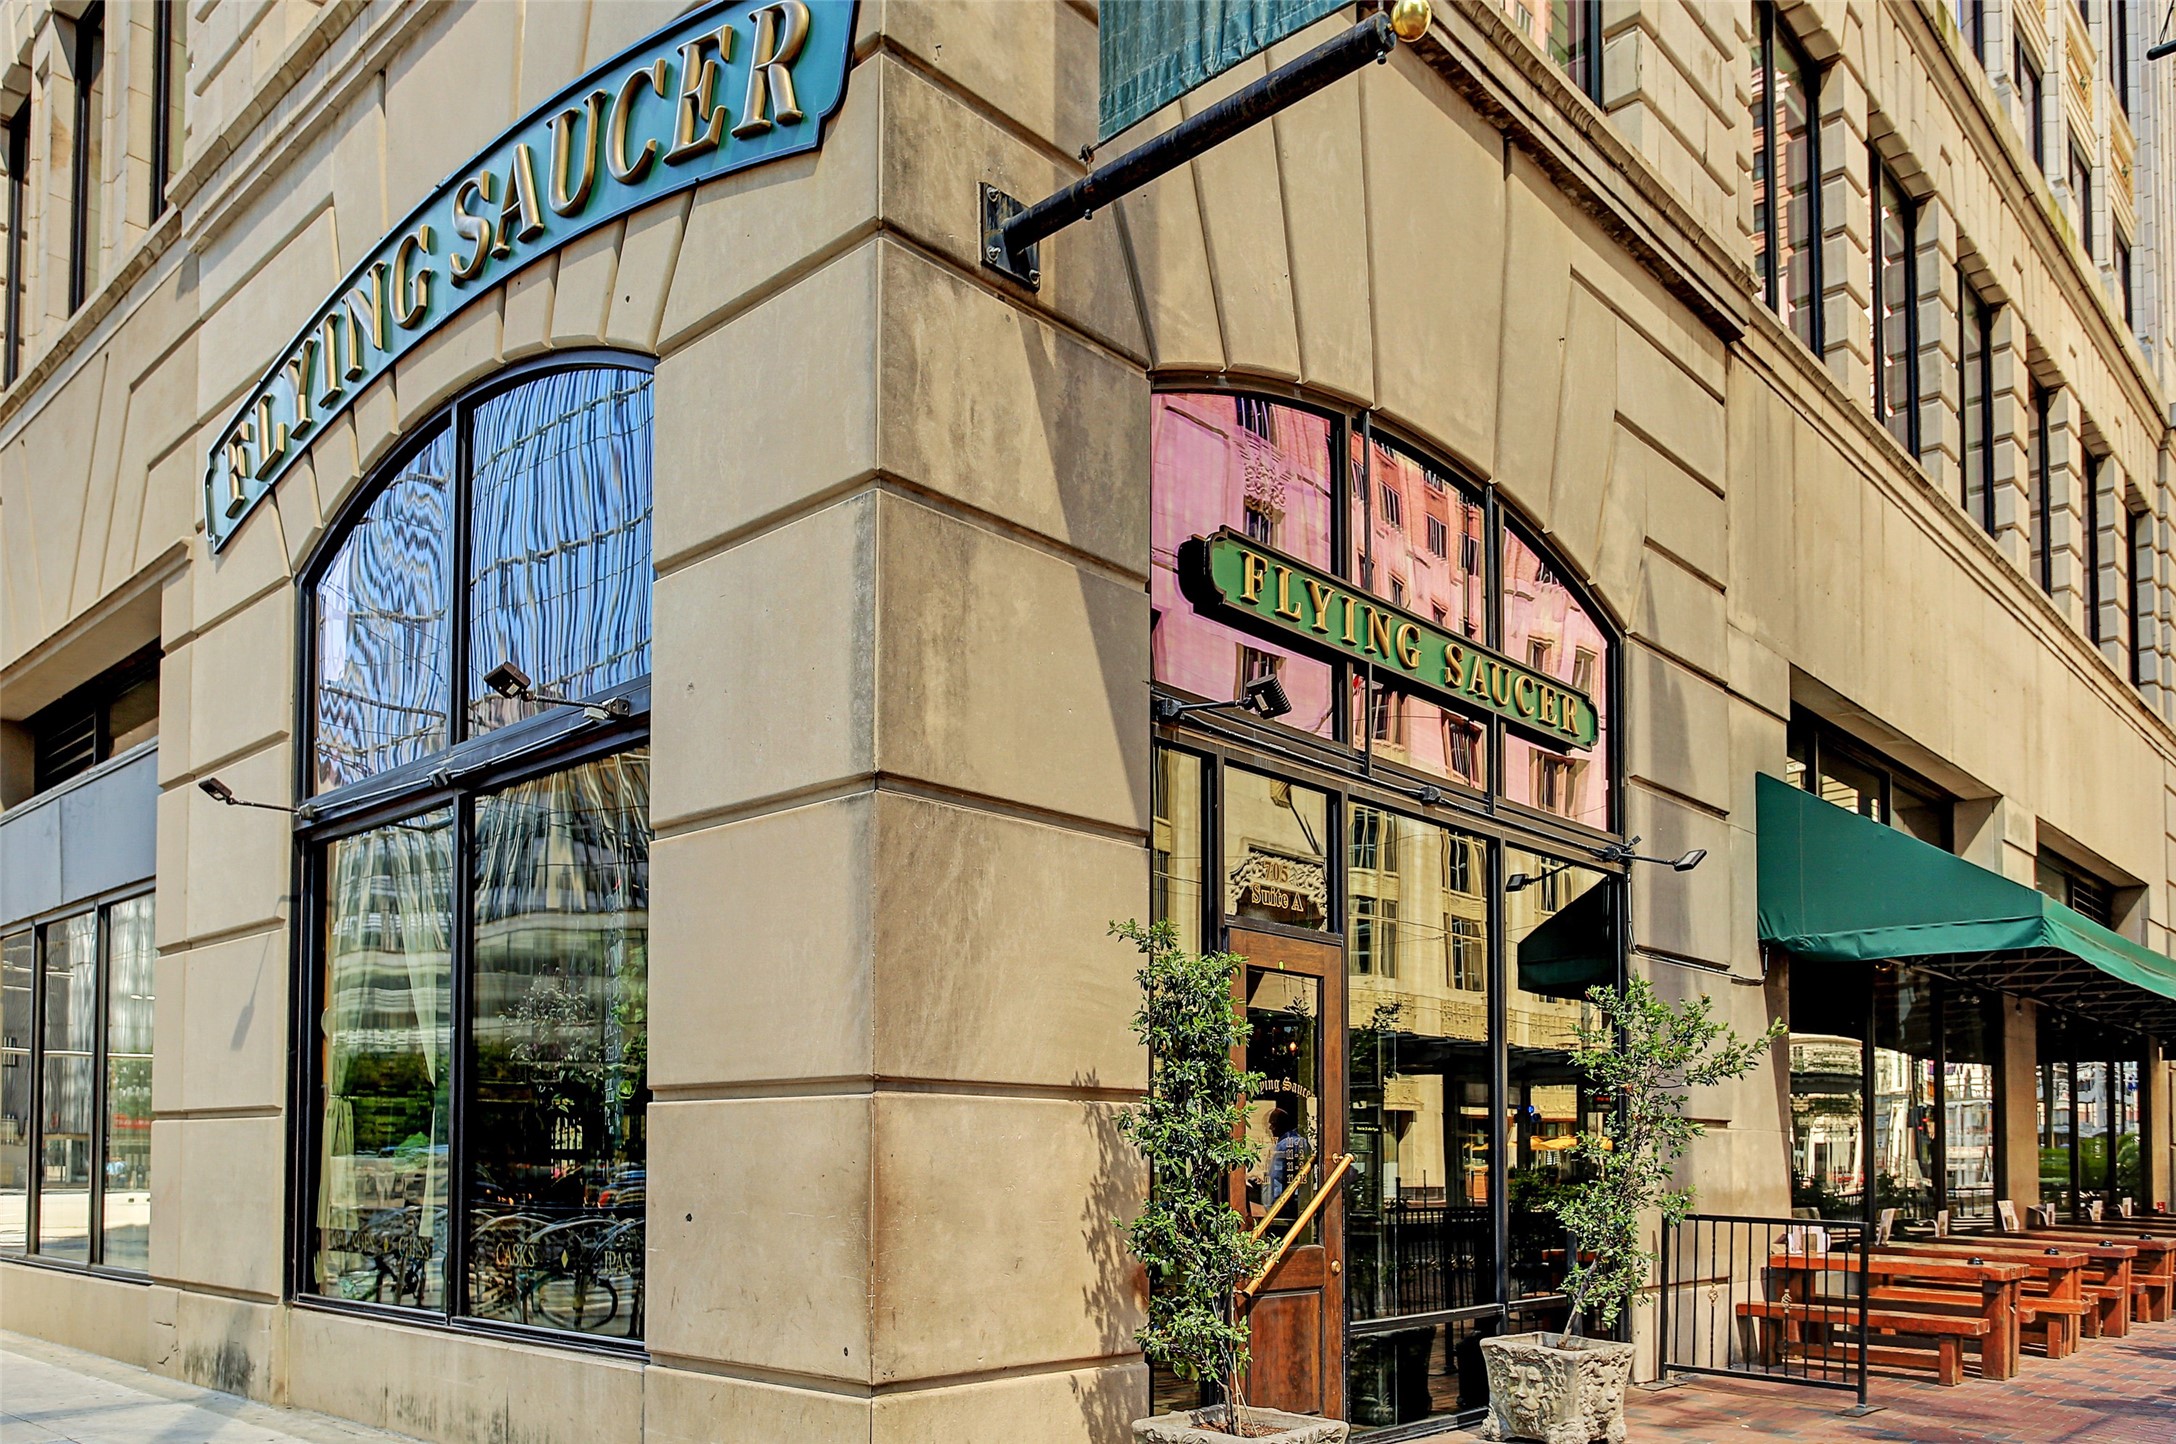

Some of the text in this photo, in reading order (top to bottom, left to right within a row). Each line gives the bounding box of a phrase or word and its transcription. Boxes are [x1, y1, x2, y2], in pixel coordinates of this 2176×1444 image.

[223, 0, 812, 519] FLYING SAUCER
[1240, 550, 1581, 737] FLYING SAUCER
[1263, 861, 1289, 882] 705
[1251, 881, 1304, 912] Suite A
[1250, 1079, 1281, 1096] ying
[495, 1242, 633, 1274] CASKS IPAS
